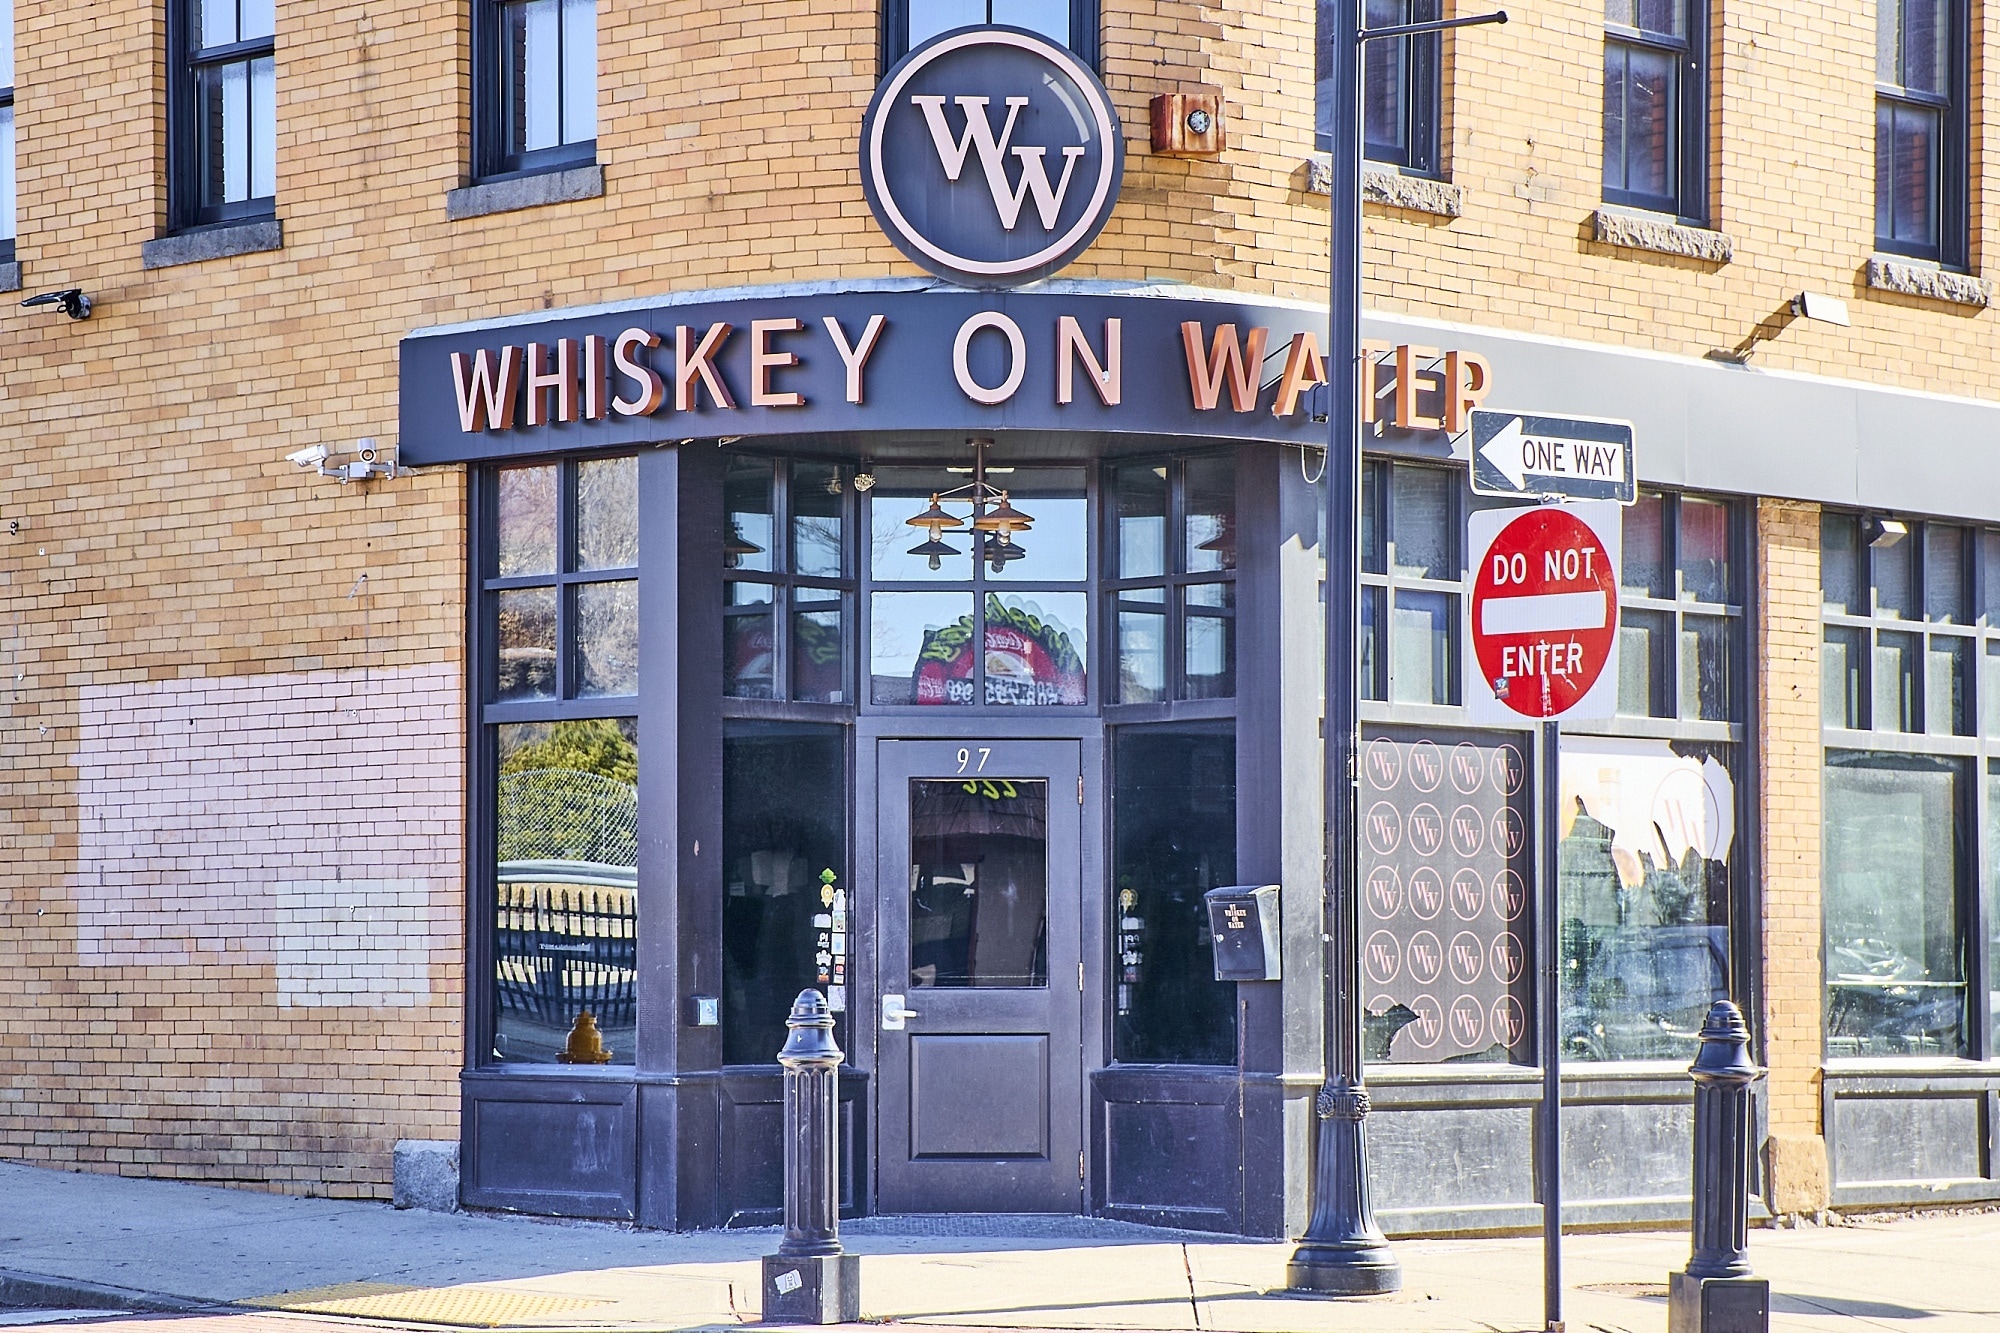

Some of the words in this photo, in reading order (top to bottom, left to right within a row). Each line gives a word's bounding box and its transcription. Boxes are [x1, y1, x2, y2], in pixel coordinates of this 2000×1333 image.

[450, 315, 888, 434] WHISKEY
[953, 311, 1121, 405] ON
[1181, 320, 1493, 434] WATER
[1522, 440, 1566, 473] ONE
[1574, 444, 1617, 477] WAY
[1493, 552, 1527, 586] DO
[1544, 547, 1596, 582] NOT
[1502, 642, 1584, 678] ENTER
[957, 748, 991, 774] 97
